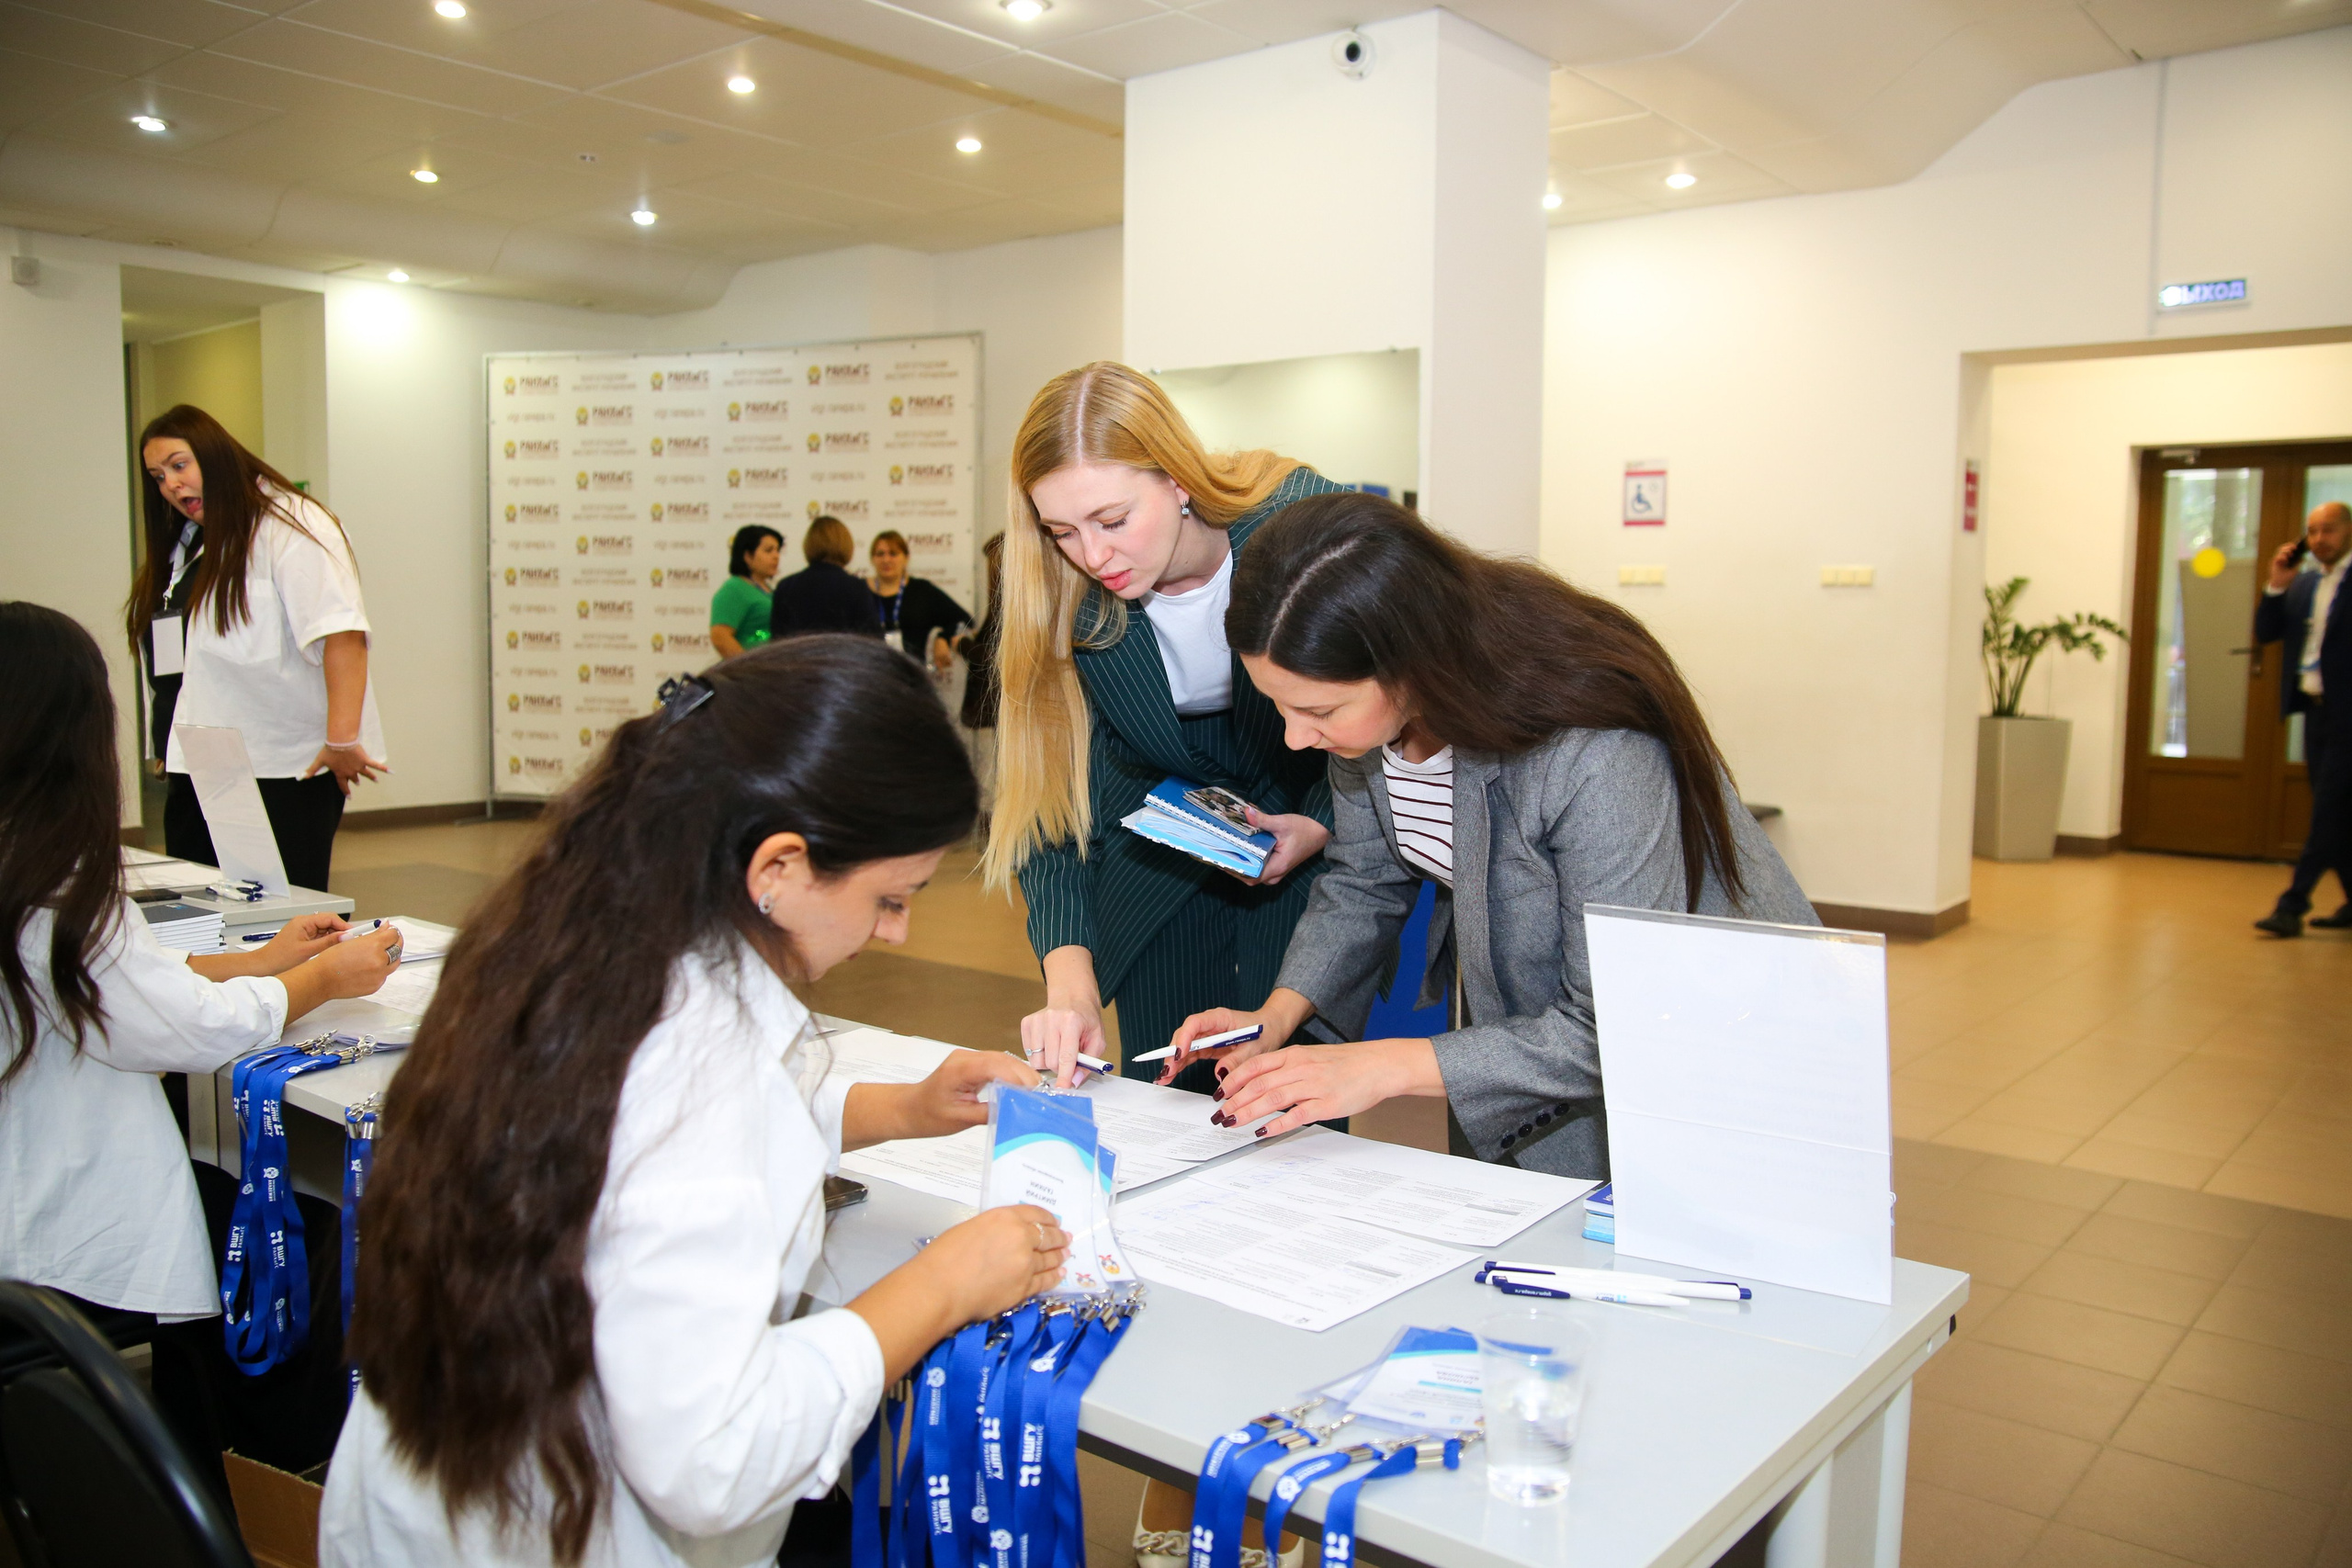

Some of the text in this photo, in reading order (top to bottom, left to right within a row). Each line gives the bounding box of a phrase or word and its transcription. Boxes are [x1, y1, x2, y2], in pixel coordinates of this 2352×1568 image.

[2162, 280, 2245, 306] ЫХОД
[230, 1226, 240, 1248] ВШГУ
[277, 1245, 285, 1267] ВШГУ
[1022, 1422, 1036, 1462] ВШГУ
[1035, 1424, 1044, 1462] РАНХиГС
[990, 1442, 1004, 1480] ВШГУ
[931, 1499, 942, 1535] РАНХиГС
[939, 1498, 953, 1533] ВШГУ
